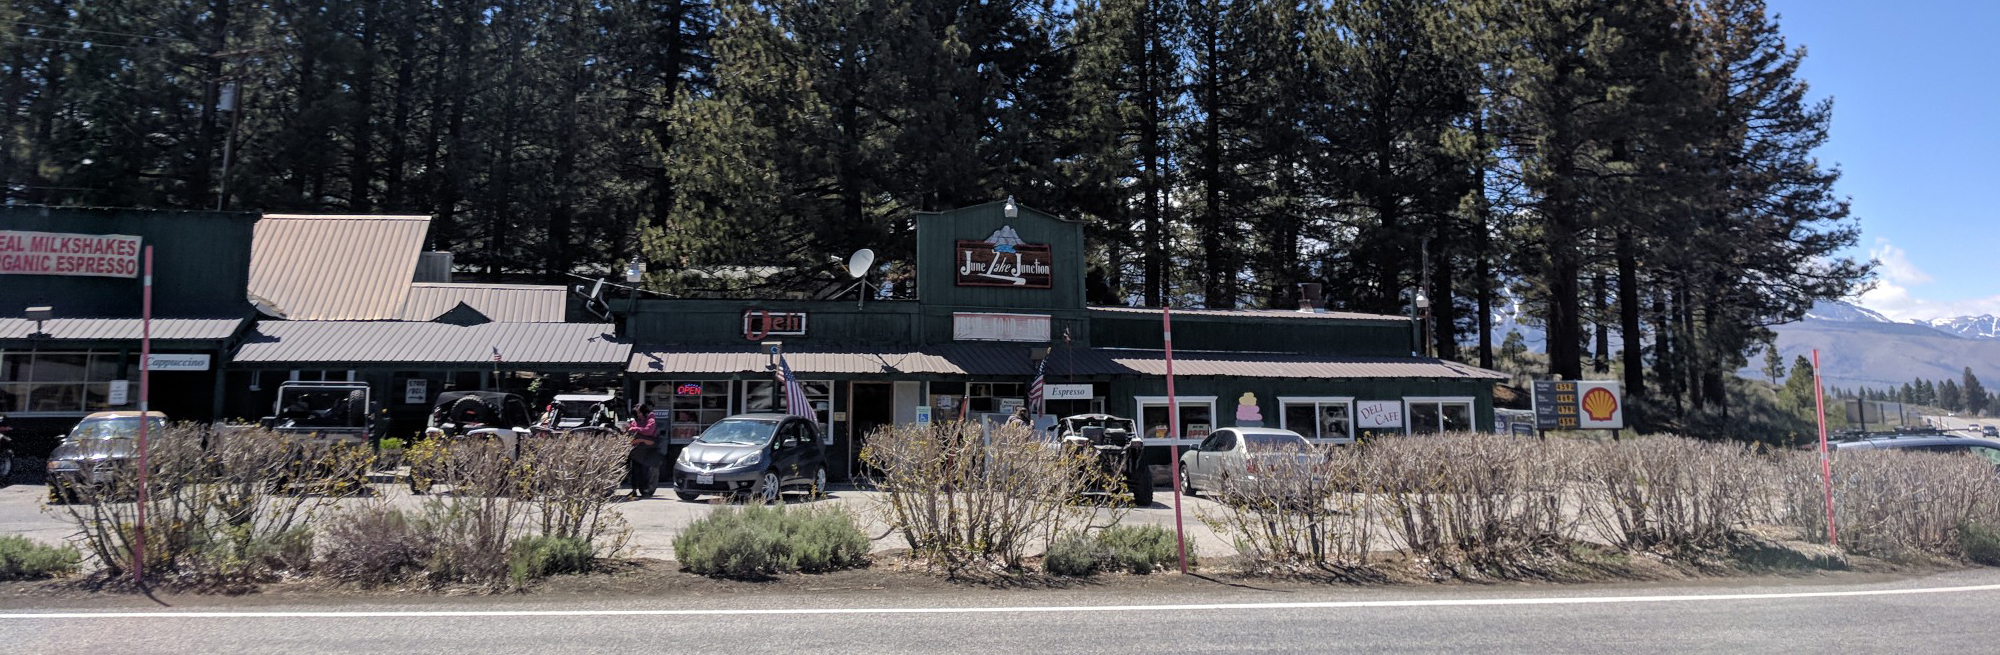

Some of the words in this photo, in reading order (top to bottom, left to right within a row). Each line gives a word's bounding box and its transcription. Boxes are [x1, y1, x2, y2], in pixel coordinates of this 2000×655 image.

[30, 236, 137, 257] MILKSHAKES
[0, 254, 51, 272] GANIC
[56, 255, 136, 275] ESPRESSO
[960, 250, 986, 276] June
[1011, 253, 1050, 277] Junction
[746, 310, 799, 340] Deli
[993, 316, 1017, 336] FOOD
[146, 357, 205, 369] Cappuccino
[677, 386, 702, 395] OPEN
[1052, 387, 1085, 397] Espresso
[1360, 403, 1383, 420] DELI
[1375, 410, 1399, 425] CAFE
